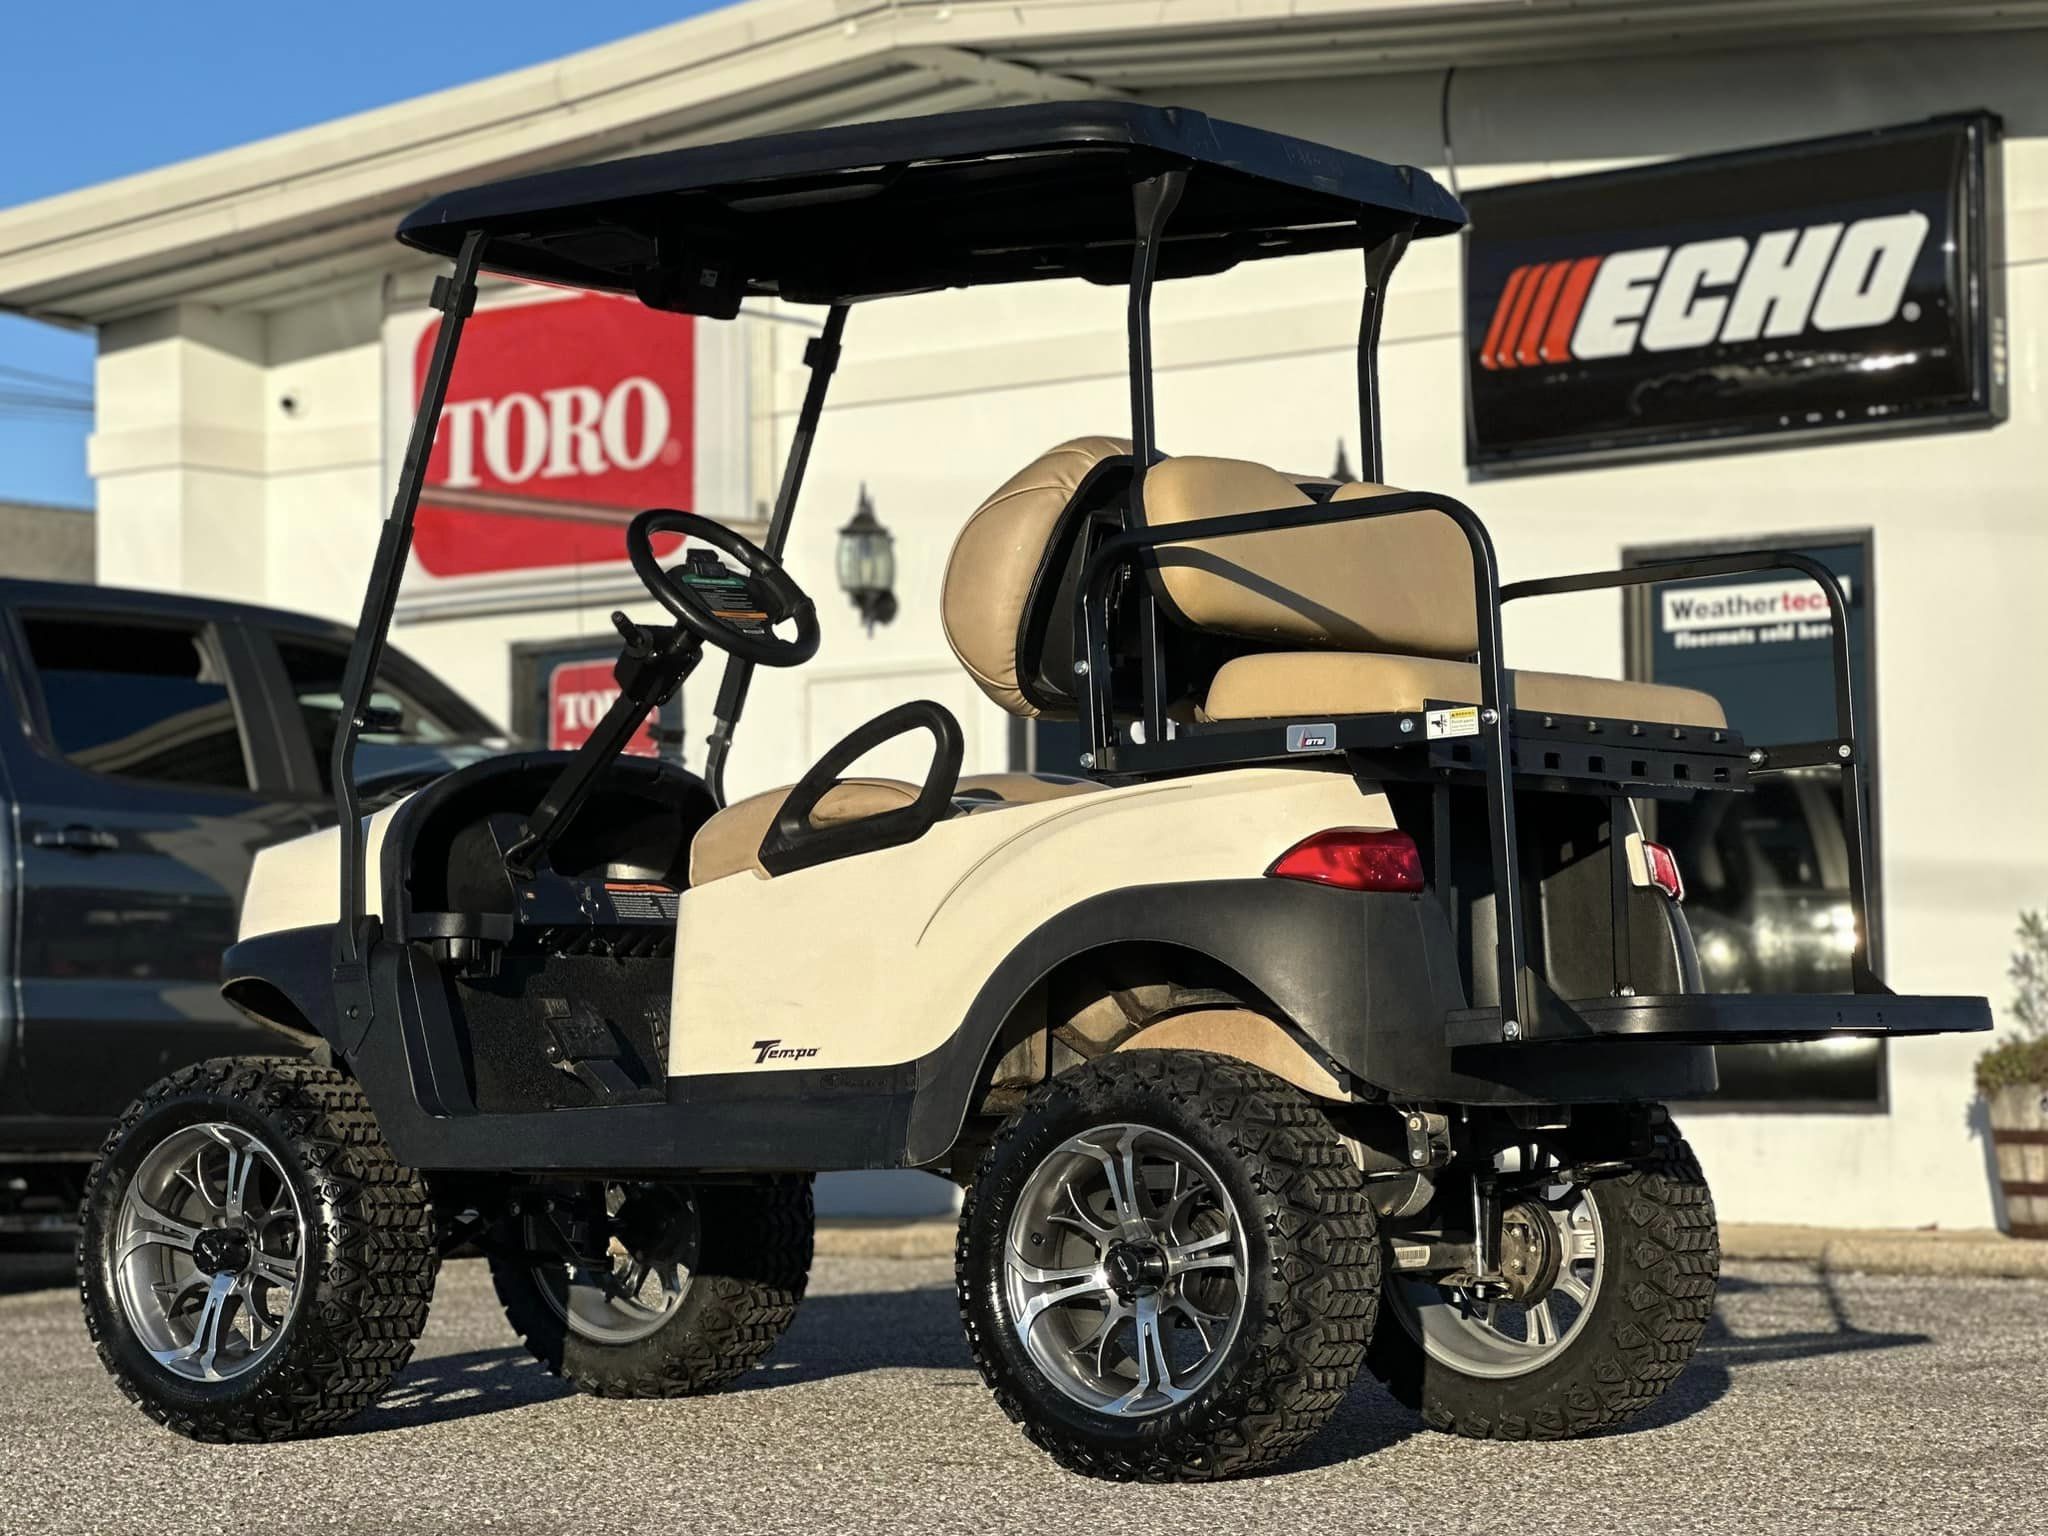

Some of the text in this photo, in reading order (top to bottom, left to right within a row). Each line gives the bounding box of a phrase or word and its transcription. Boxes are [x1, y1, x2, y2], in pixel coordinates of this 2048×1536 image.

[1571, 213, 1930, 360] ECHO
[434, 376, 671, 488] TORO
[752, 1039, 818, 1064] Tempo
